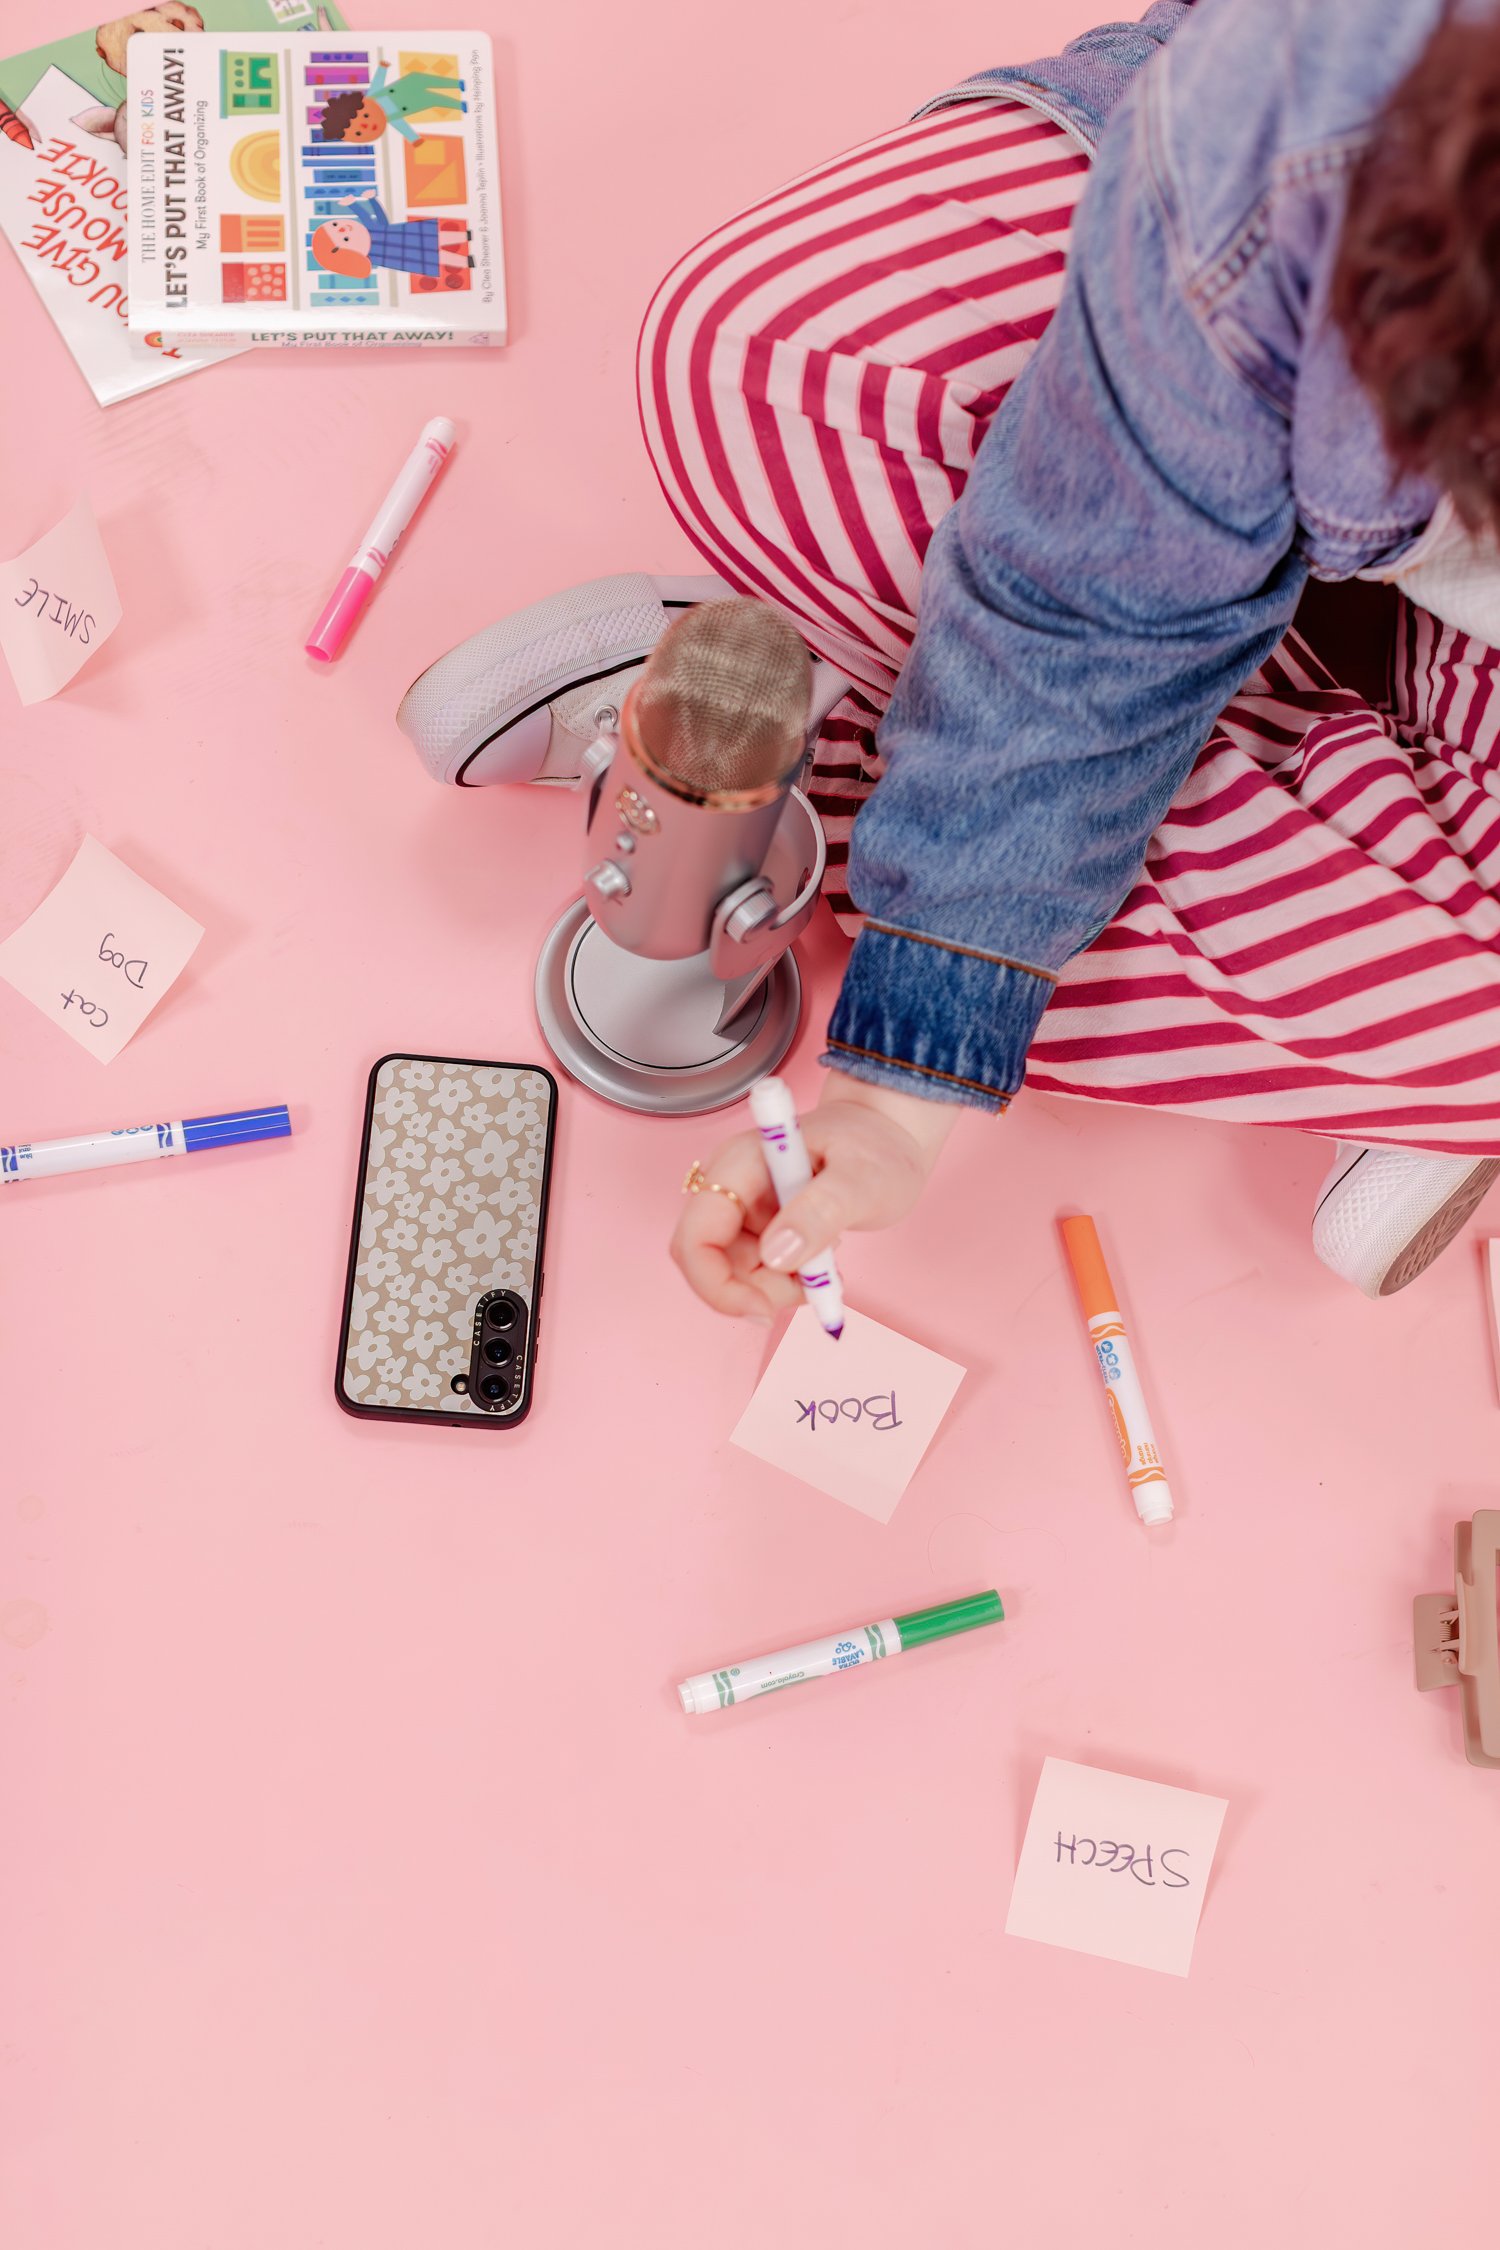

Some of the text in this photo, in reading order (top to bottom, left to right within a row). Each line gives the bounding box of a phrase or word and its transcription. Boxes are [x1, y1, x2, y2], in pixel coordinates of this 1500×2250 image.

[163, 48, 185, 124] AWAY!
[141, 90, 156, 263] THE HOME EDIT FOR KIDS
[164, 130, 186, 188] THAT
[194, 100, 210, 249] My First Book of Organizing
[27, 178, 128, 262] MOUSE
[164, 194, 187, 238] PUT
[20, 224, 100, 286] GIVE
[304, 332, 337, 341] PUT
[342, 332, 388, 341] THAT
[393, 331, 454, 341] AWAY!
[15, 578, 96, 644] SMILE
[98, 932, 148, 989] Dog
[760, 1671, 805, 1690] Crayola.com
[832, 1648, 864, 1666] LAVABLE
[1053, 1831, 1190, 1888] SPEECH
